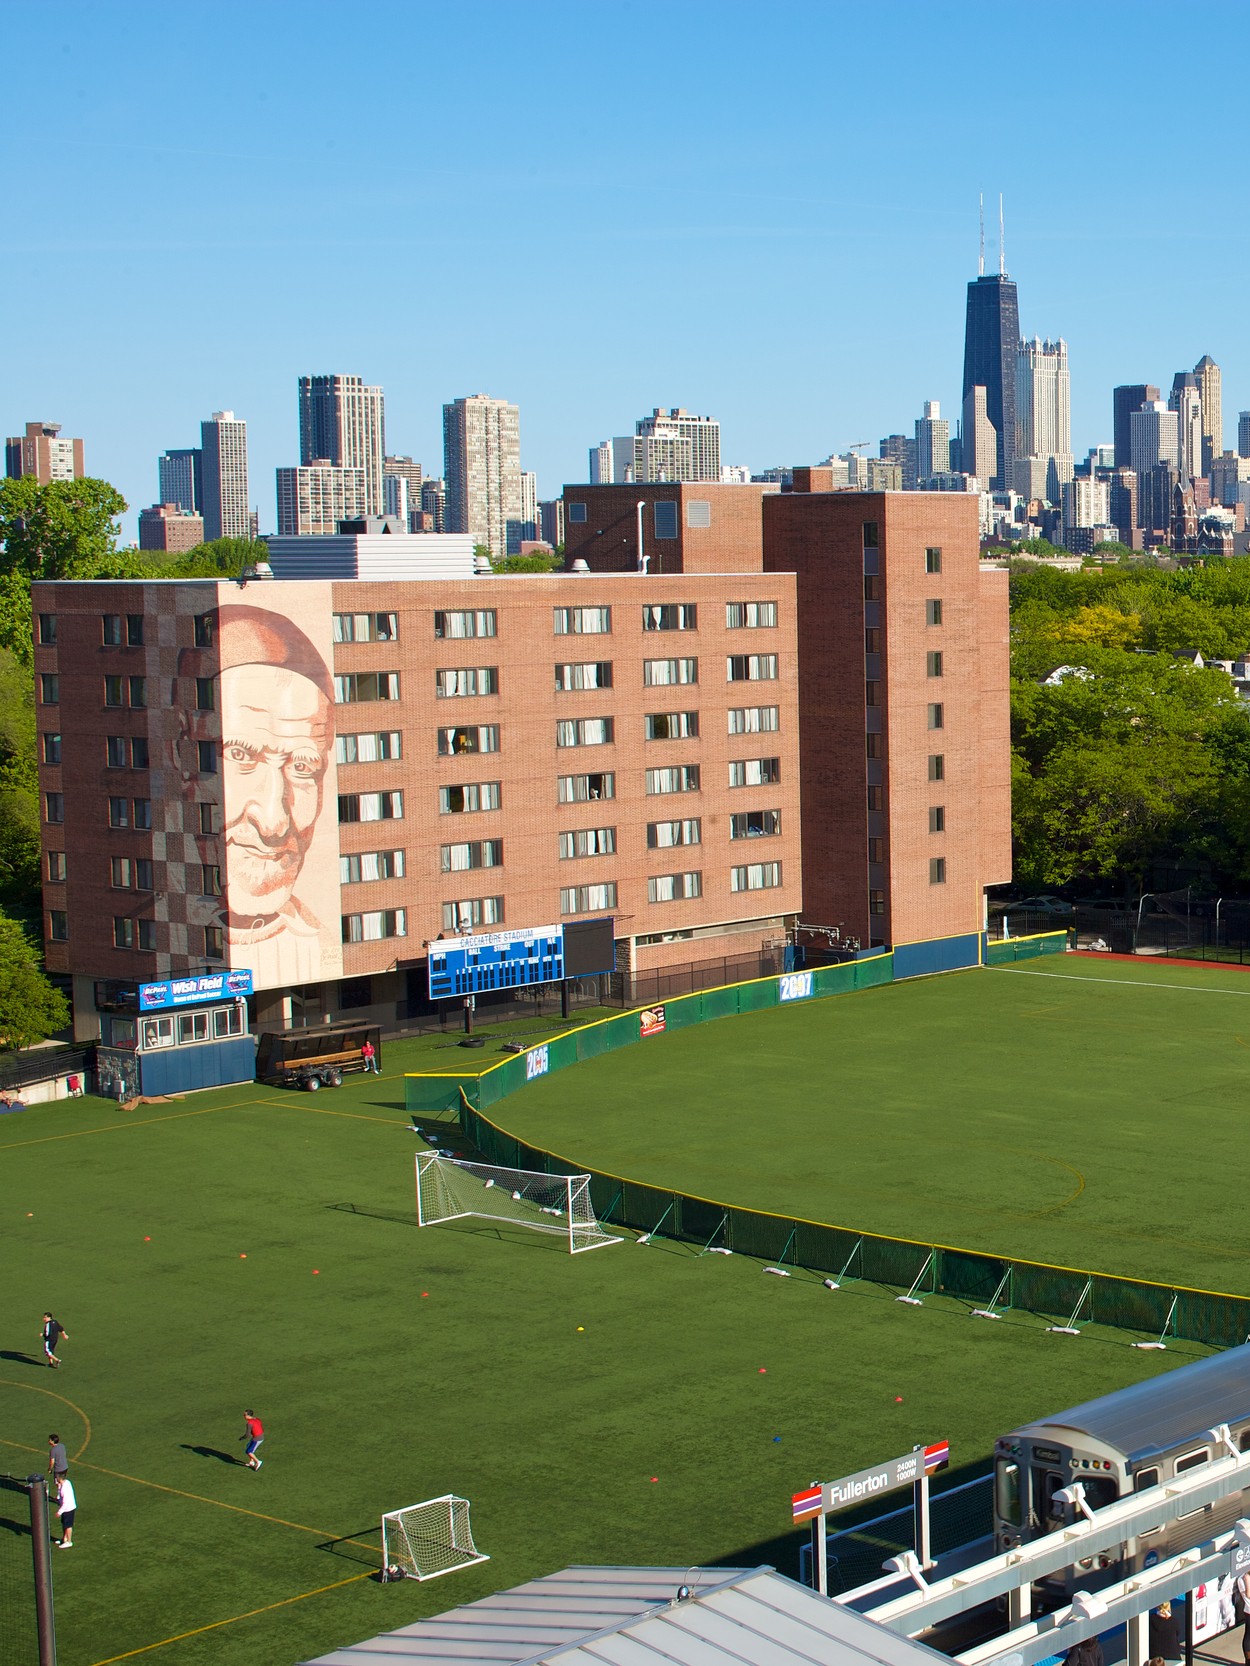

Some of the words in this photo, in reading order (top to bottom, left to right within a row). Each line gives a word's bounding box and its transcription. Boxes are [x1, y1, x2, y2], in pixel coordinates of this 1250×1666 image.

[461, 933, 501, 947] CACCIATORE
[503, 930, 533, 941] STADIUM
[524, 940, 534, 948] OUT
[468, 947, 481, 955] BALL
[494, 943, 511, 952] STRIKE
[433, 952, 446, 960] MPH
[172, 980, 197, 994] Wish
[199, 977, 223, 990] Field
[781, 973, 812, 1000] 2007
[528, 1045, 548, 1078] 2005
[896, 1458, 916, 1473] 2400N
[896, 1468, 916, 1482] 1000W
[831, 1473, 888, 1505] Fullerton
[1236, 1558, 1250, 1570] Elevator
